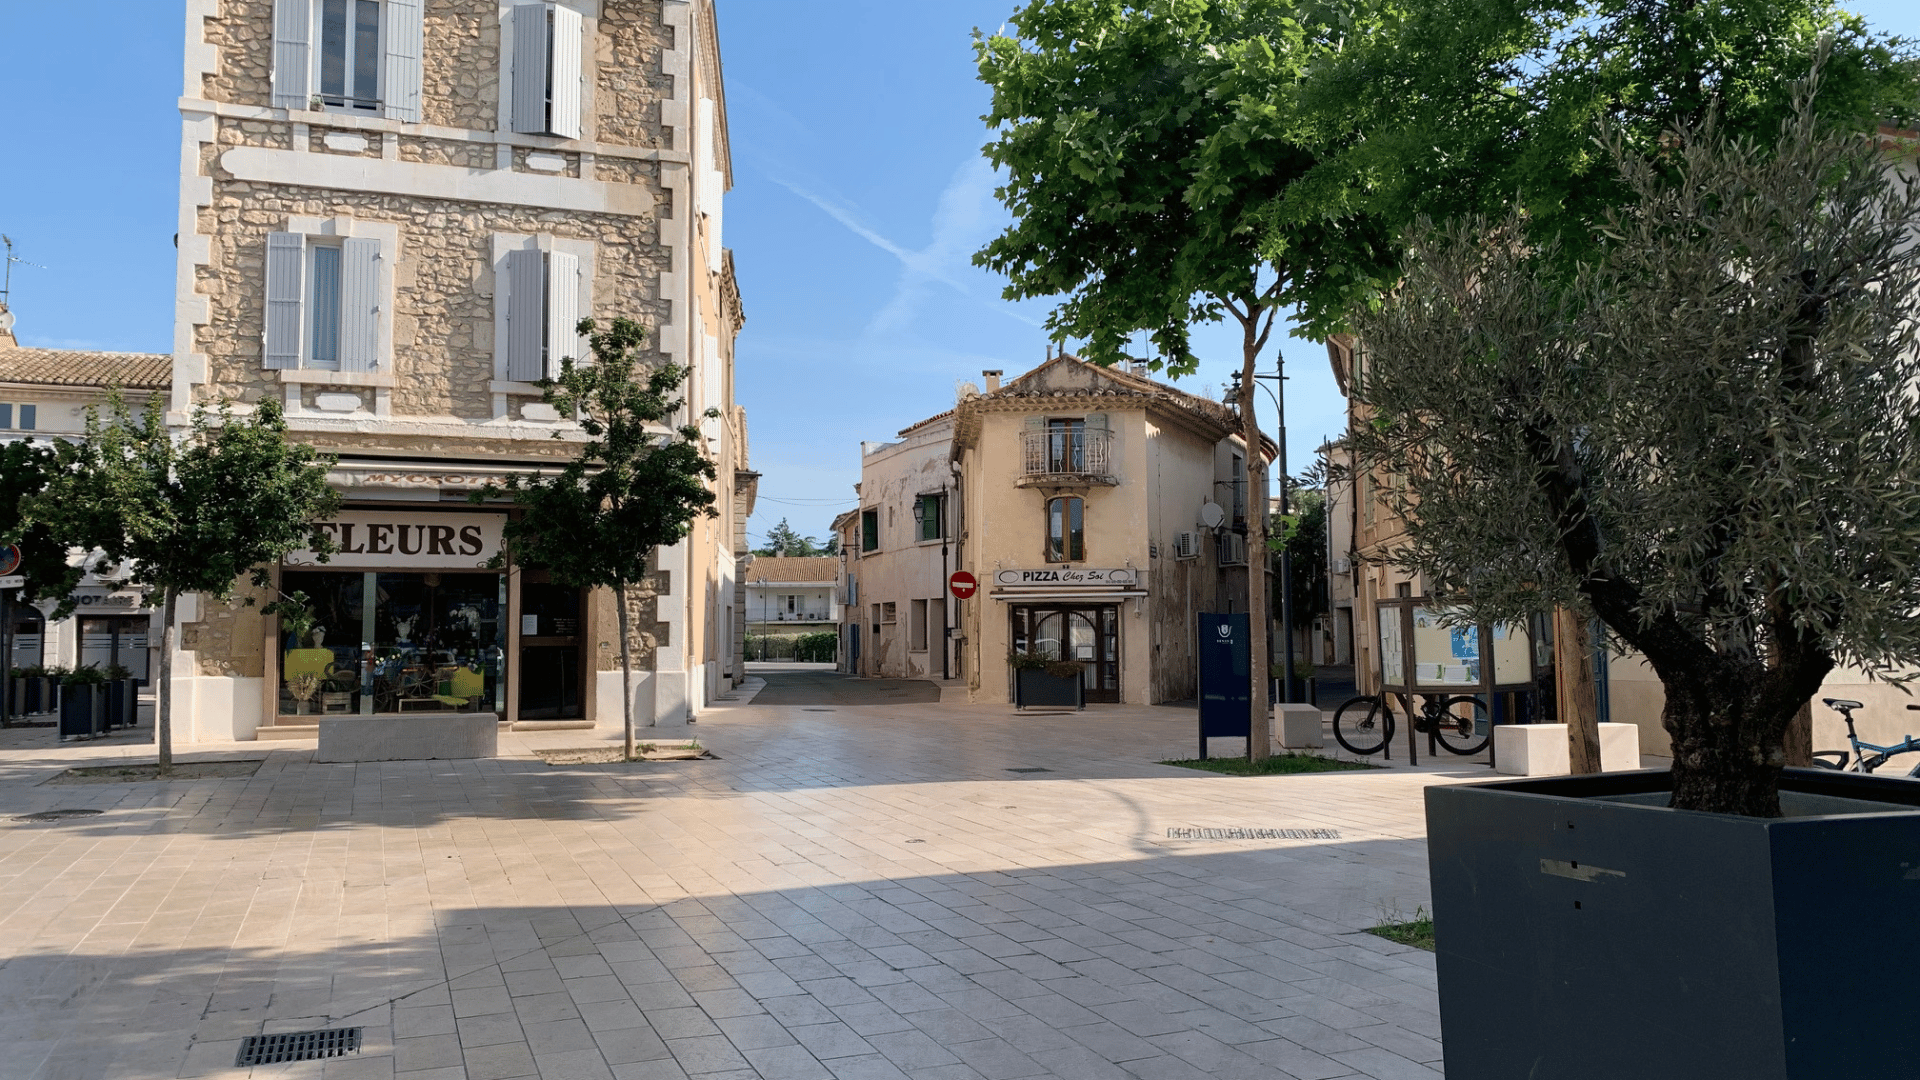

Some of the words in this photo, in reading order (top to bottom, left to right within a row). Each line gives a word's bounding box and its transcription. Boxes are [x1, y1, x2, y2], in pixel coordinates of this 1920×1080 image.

[363, 473, 507, 486] MYOSOTIS
[310, 522, 483, 556] FLEURS
[1022, 571, 1060, 582] PIZZA
[1062, 571, 1084, 583] Chez
[1087, 571, 1104, 580] Soi
